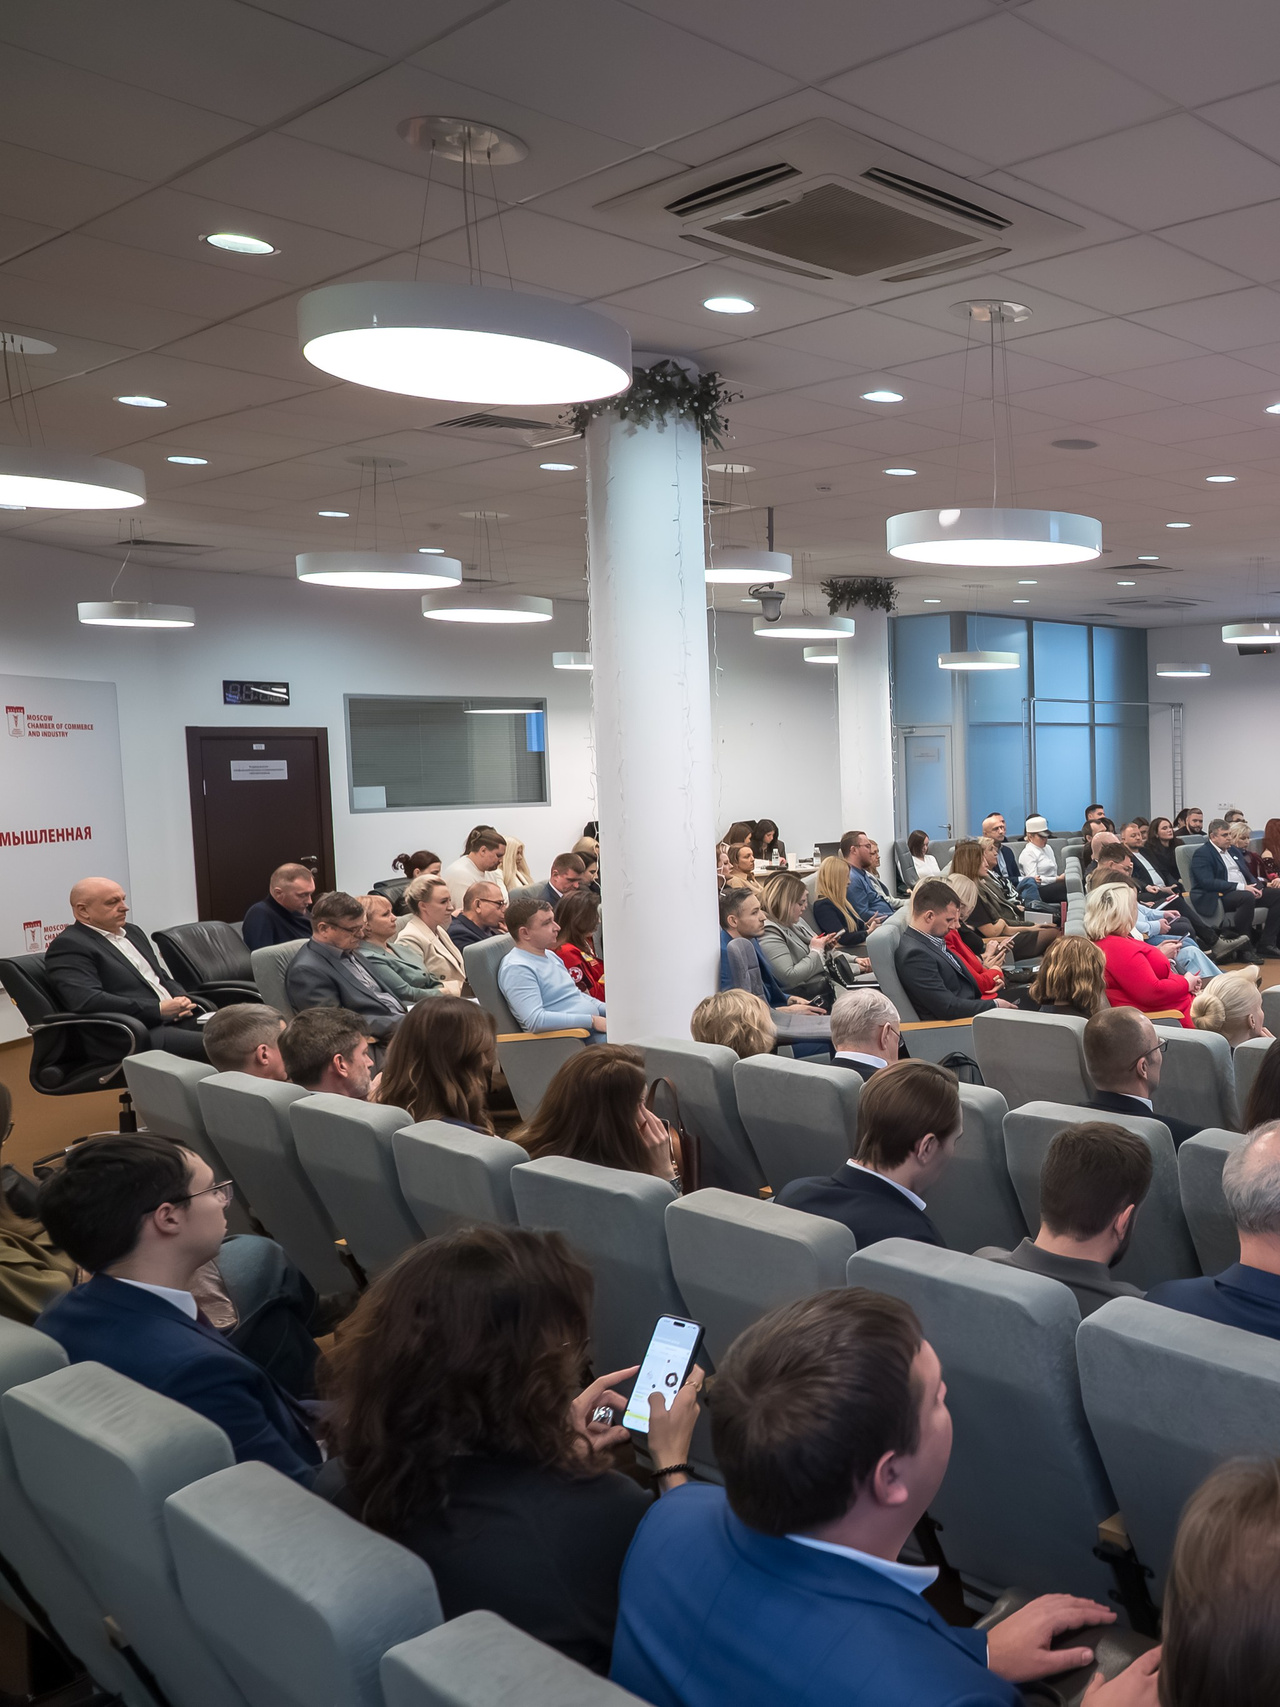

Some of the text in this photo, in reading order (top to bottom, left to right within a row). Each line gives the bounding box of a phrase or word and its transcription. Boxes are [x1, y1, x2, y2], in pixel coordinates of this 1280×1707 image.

[26, 714, 53, 722] MOSCOW
[27, 722, 55, 730] CHAMBER
[64, 723, 94, 731] COMMERCE
[28, 730, 41, 738] AND
[41, 730, 69, 738] INDUSTRY
